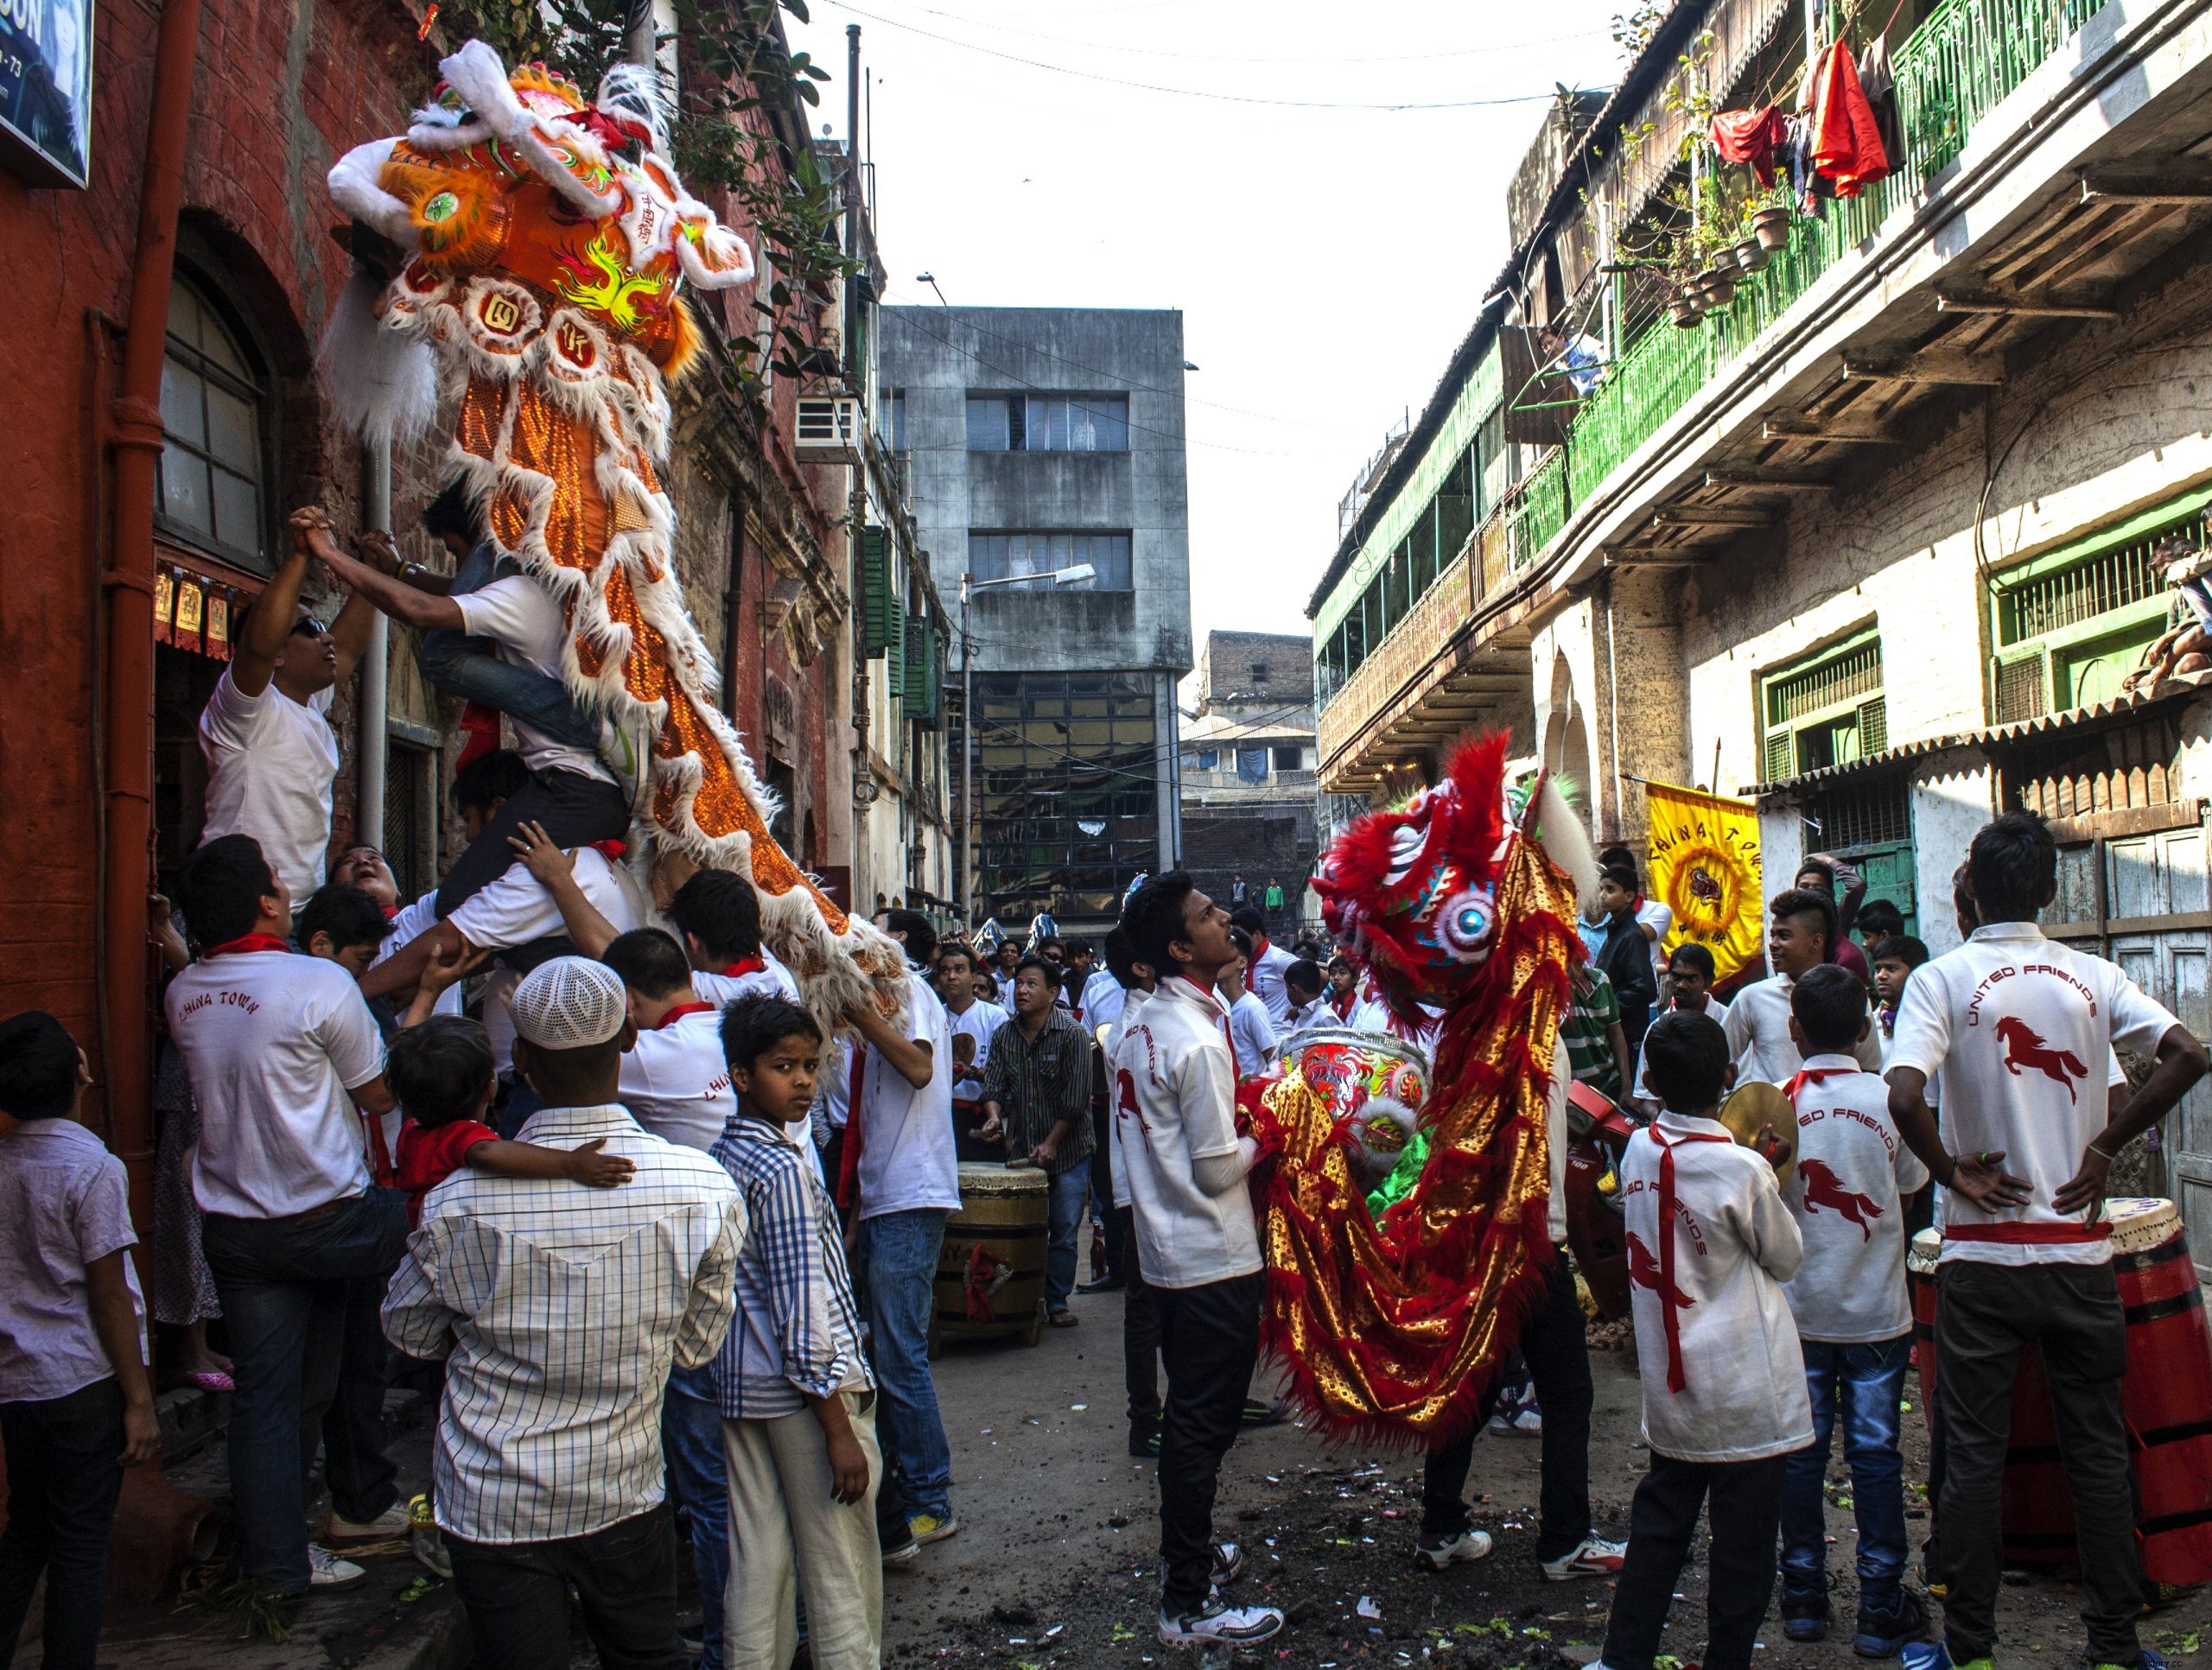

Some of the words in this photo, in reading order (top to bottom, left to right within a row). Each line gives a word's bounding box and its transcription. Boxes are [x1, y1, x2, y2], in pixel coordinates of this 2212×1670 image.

[10, 54, 22, 78] 73
[178, 992, 213, 1024] CHINA
[219, 991, 260, 1016] TOWN
[1968, 966, 2017, 1027] UNITED
[2023, 964, 2098, 1019] FRIENDS
[1798, 1109, 1826, 1127] ED
[1833, 1108, 1896, 1164] FRIENDS
